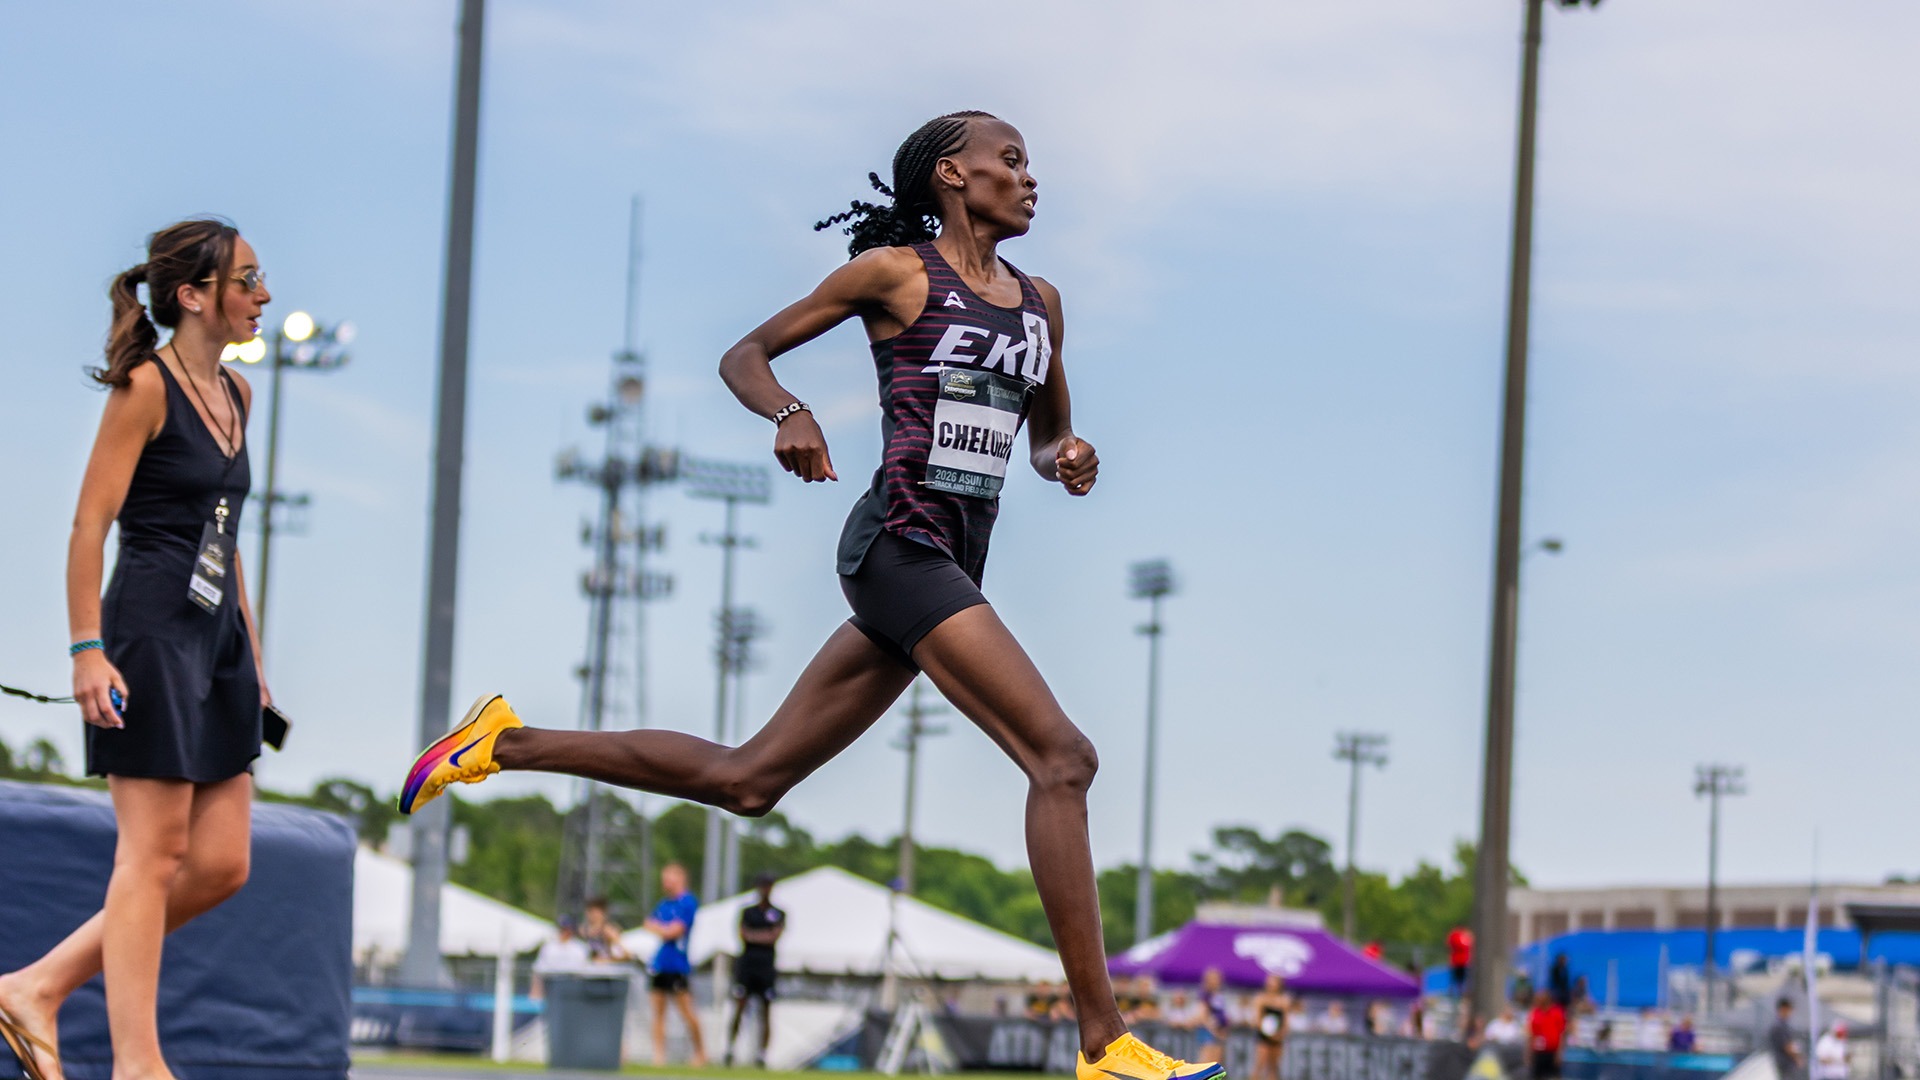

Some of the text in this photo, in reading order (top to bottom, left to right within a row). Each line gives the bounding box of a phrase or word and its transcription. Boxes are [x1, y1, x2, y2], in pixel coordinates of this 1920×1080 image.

[929, 324, 1031, 382] EK
[934, 480, 953, 489] TRACK
[935, 469, 958, 483] 2026
[958, 473, 982, 487] ASUN
